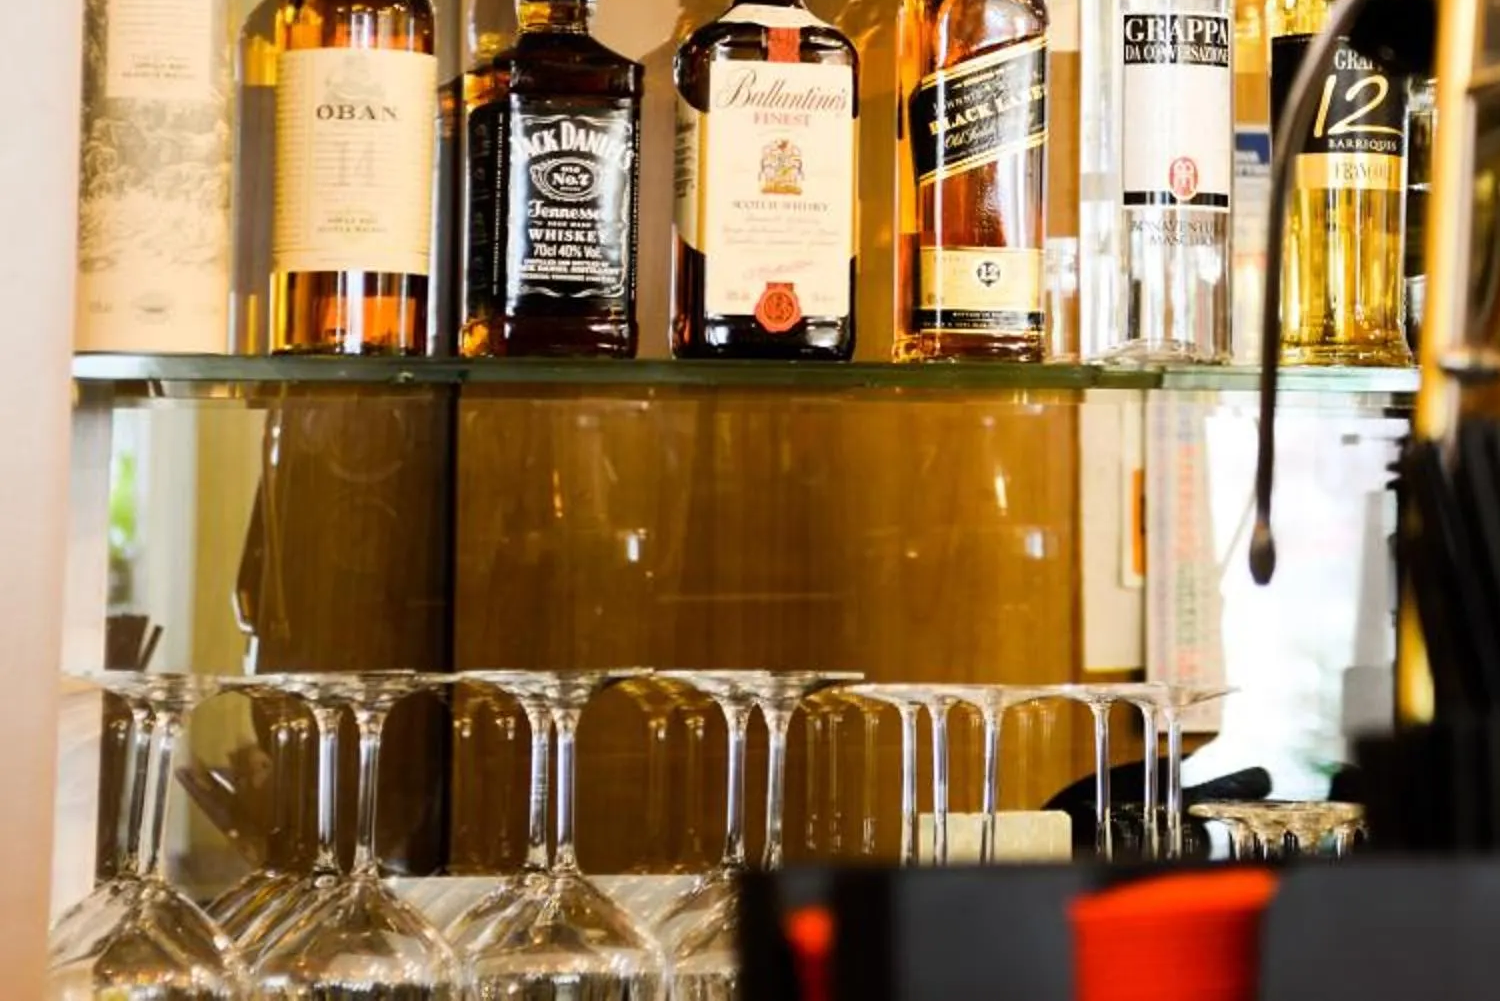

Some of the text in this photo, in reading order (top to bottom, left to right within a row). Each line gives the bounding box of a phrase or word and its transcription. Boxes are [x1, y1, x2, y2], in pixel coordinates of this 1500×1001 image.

[1125, 17, 1228, 45] GRAPPA
[1125, 44, 1141, 62] DA
[716, 66, 848, 112] Ballantine's
[315, 103, 400, 121] OBAN
[1313, 74, 1403, 138] 12
[533, 243, 557, 257] 70cl
[558, 244, 582, 258] 40%
